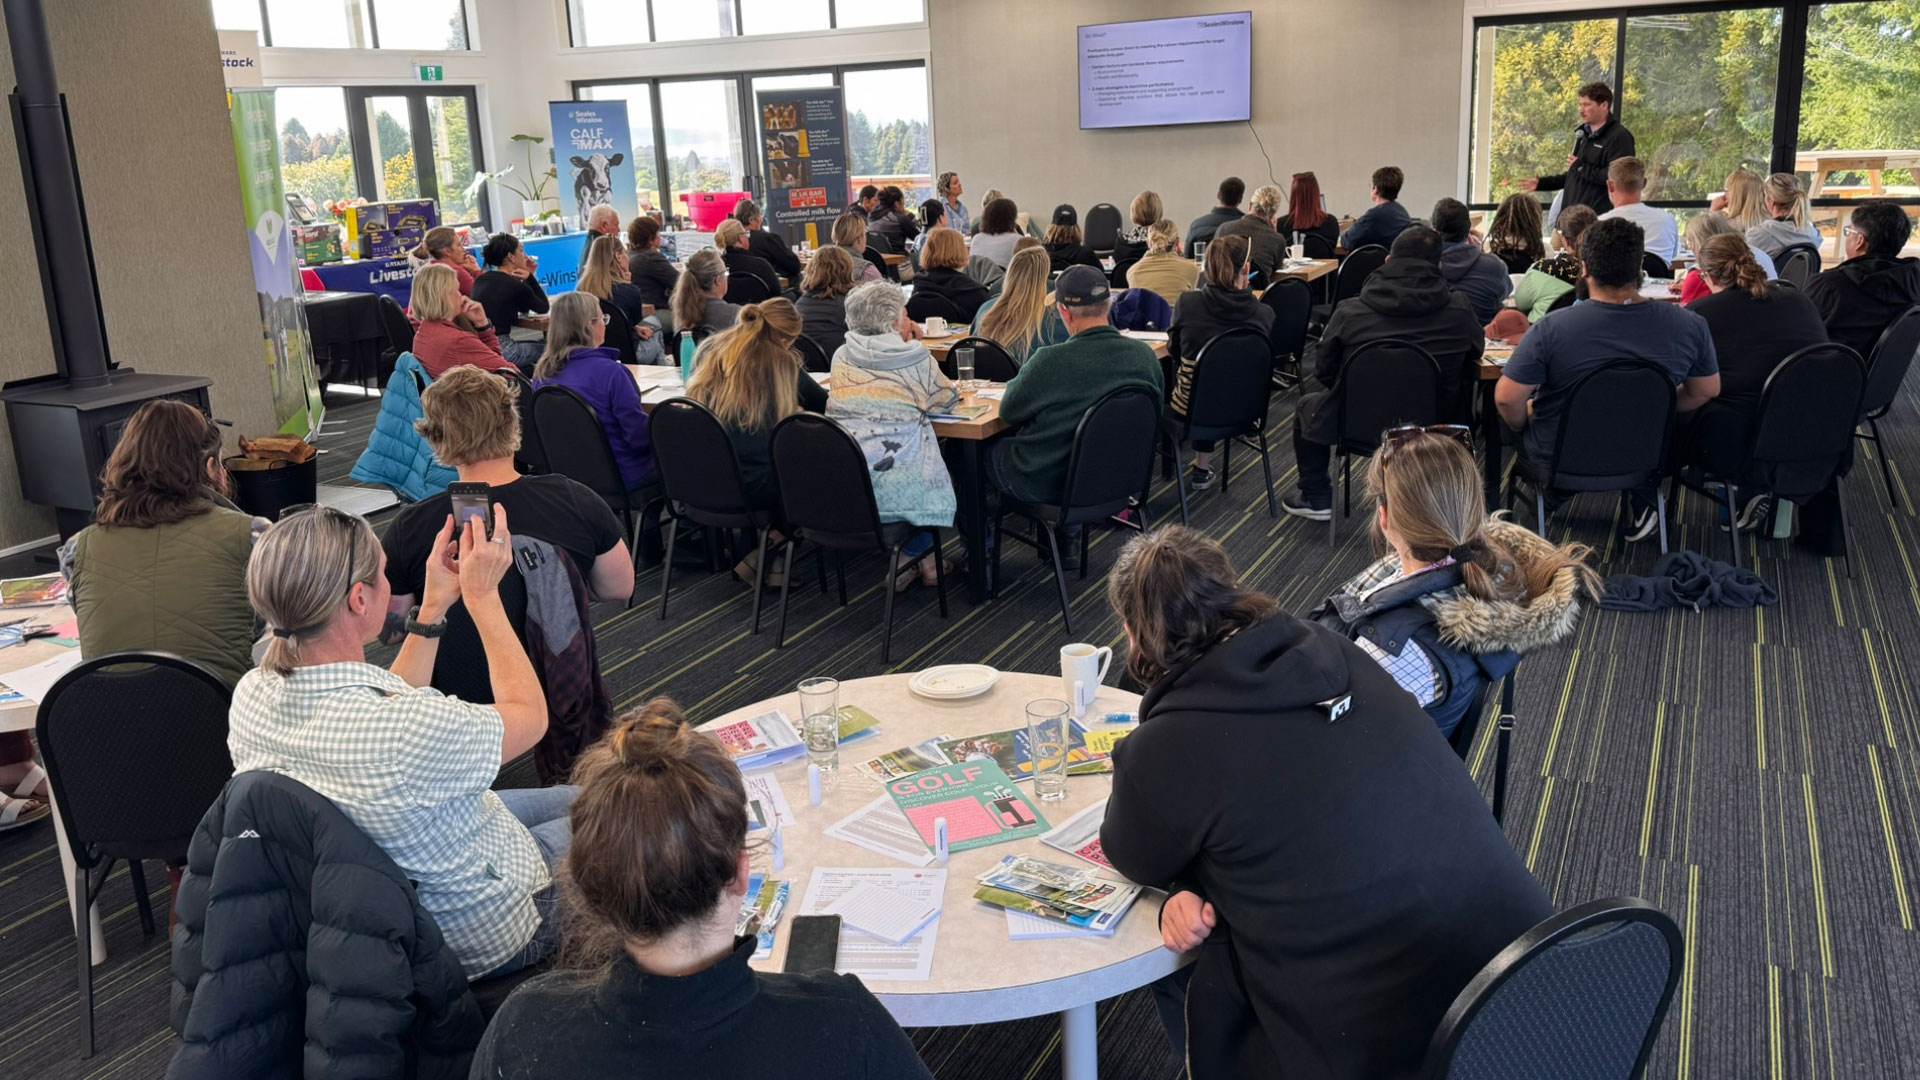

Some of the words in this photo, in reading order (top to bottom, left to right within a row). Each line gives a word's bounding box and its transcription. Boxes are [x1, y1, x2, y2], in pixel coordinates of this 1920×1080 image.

[221, 57, 254, 68] stock
[575, 110, 596, 118] Seales
[570, 128, 604, 140] CALF
[580, 138, 614, 151] MAX
[775, 209, 810, 219] Controlled
[384, 260, 409, 268] DATAM
[369, 267, 417, 284] Livesto
[891, 766, 983, 795] GOLF
